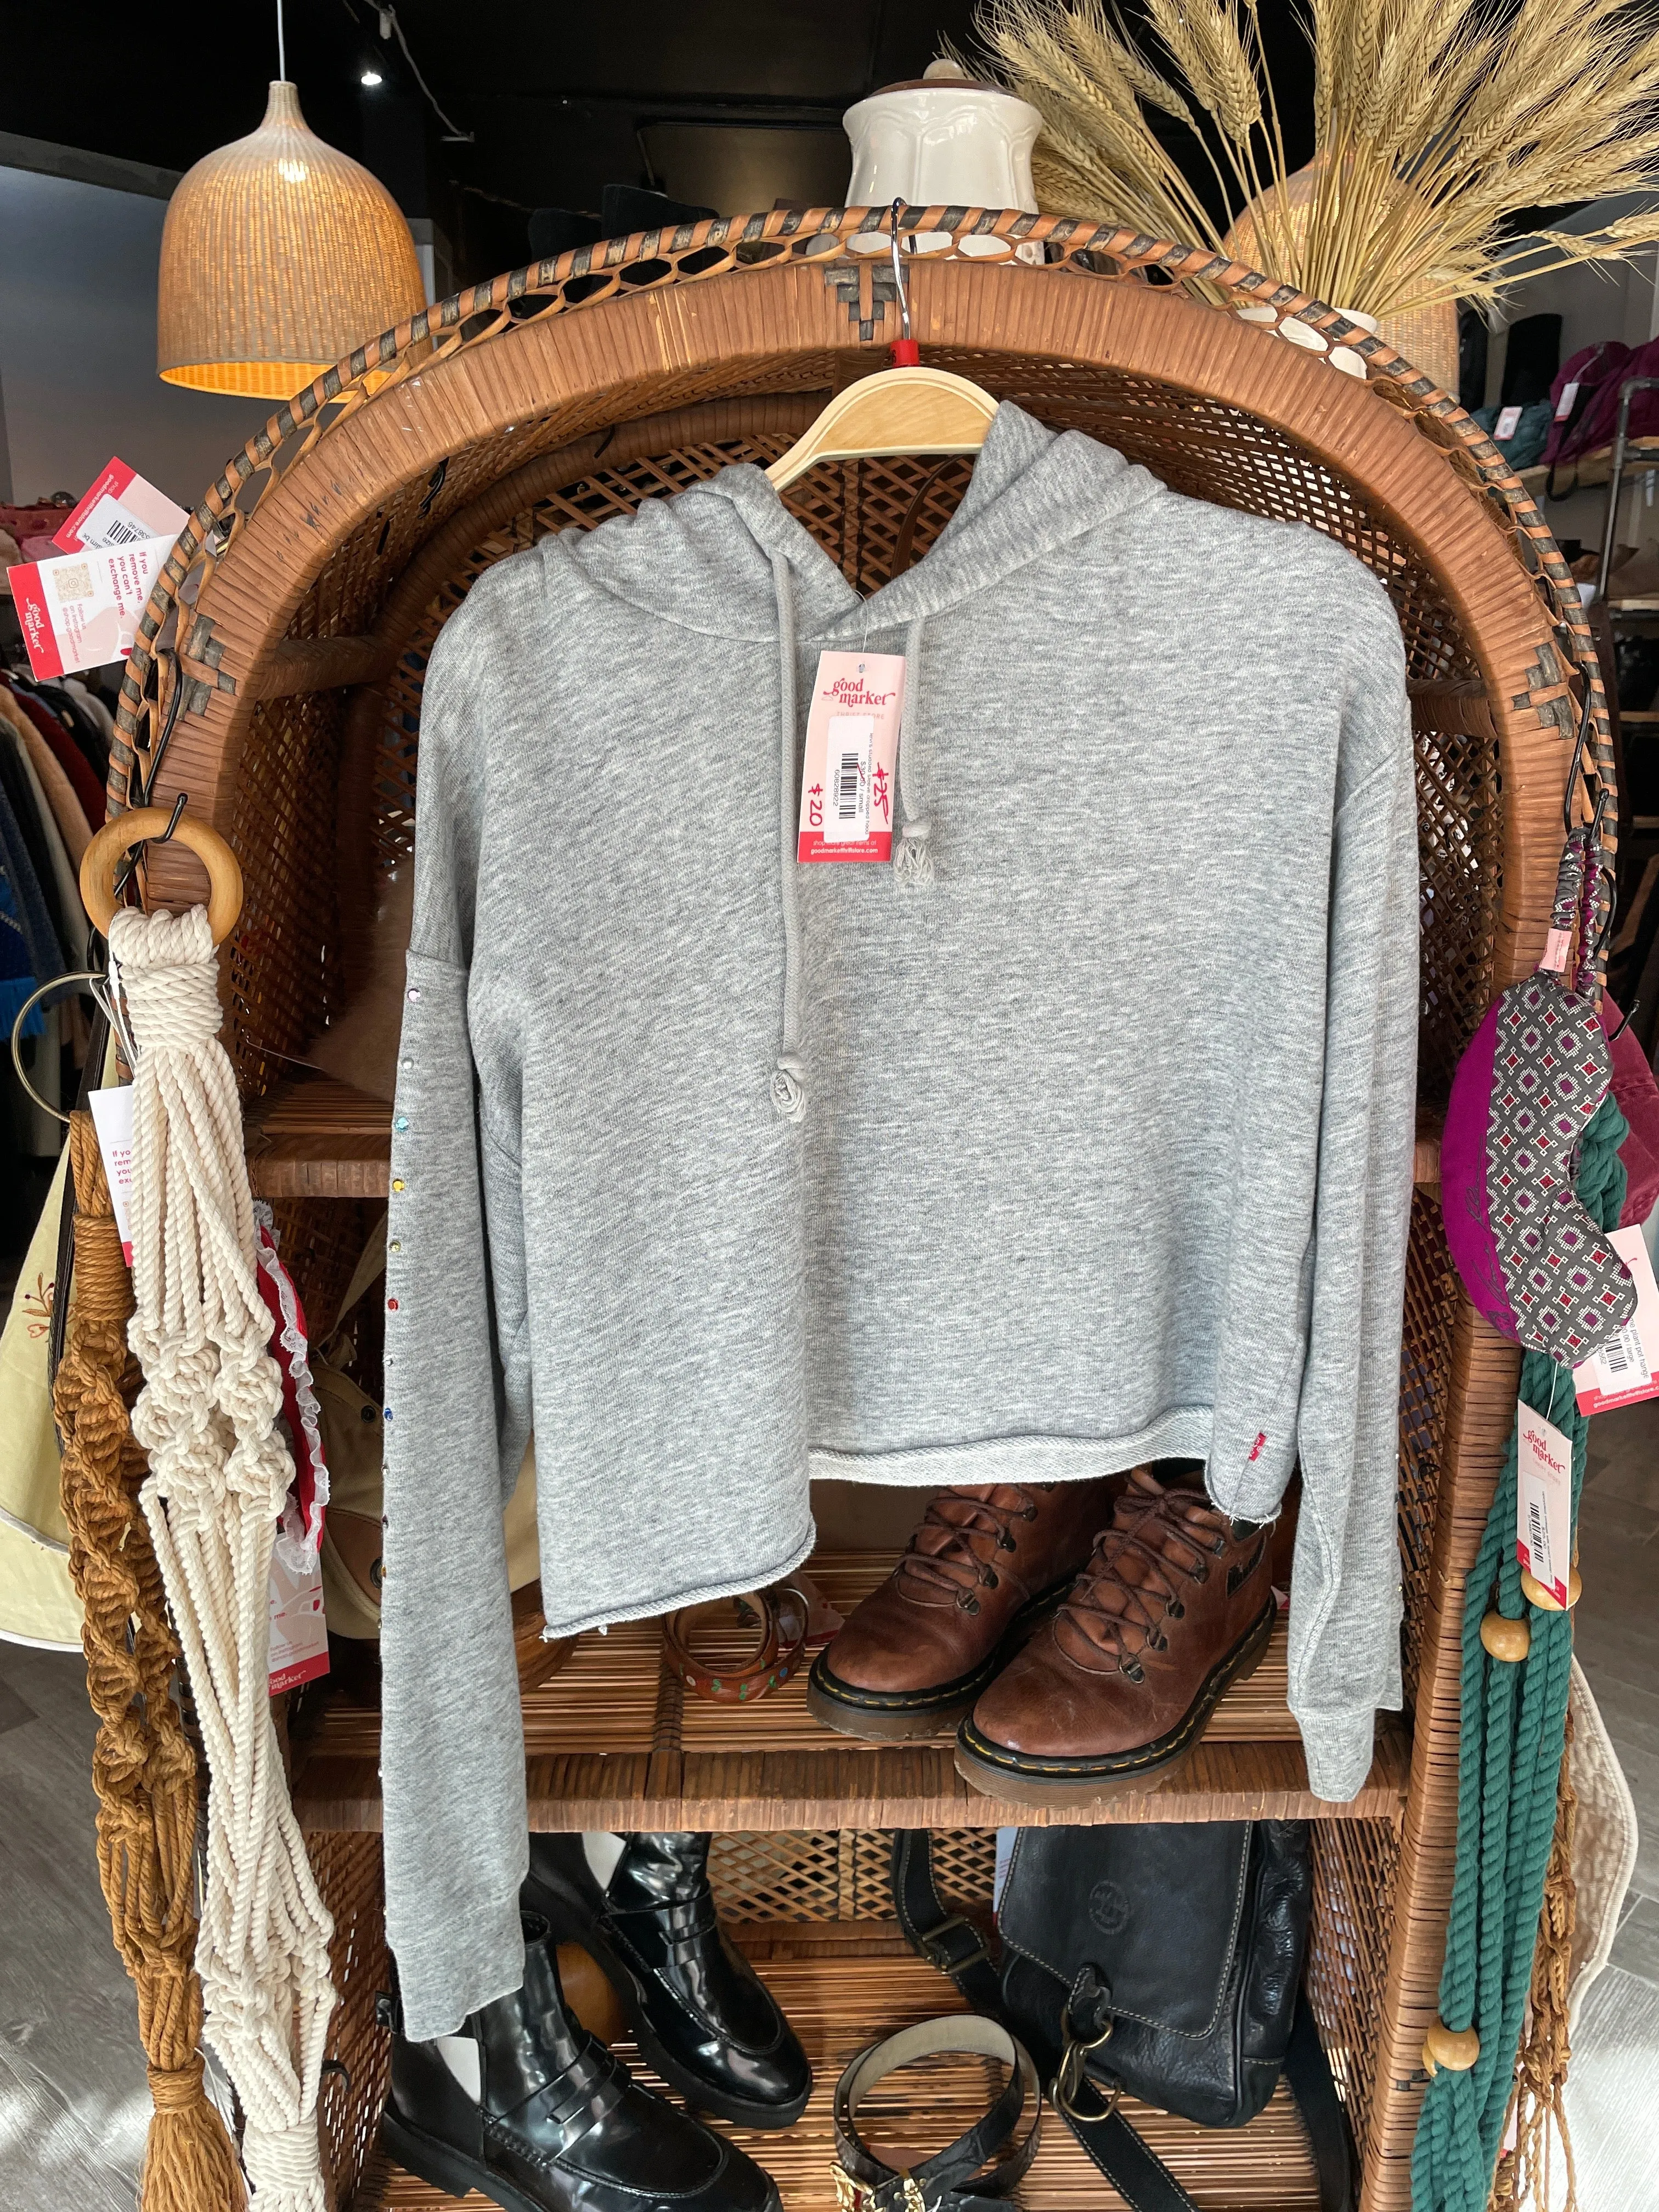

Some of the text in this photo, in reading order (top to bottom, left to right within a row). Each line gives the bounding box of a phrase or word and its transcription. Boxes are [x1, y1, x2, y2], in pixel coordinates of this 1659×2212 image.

[117, 556, 133, 595] you can't
[129, 554, 140, 585] remove
[139, 559, 149, 574] you
[108, 558, 122, 601] exchange
[26, 597, 45, 629] good
[25, 612, 44, 653] market
[823, 678, 864, 696] good
[838, 691, 896, 708] market
[808, 783, 823, 826] $20
[810, 847, 878, 855] goodmarketthriftstore.com
[1629, 1329, 1641, 1346] plant
[1598, 1348, 1607, 1364] 5562
[1626, 1347, 1634, 1363] large
[1634, 1346, 1644, 1357] pot
[1593, 1386, 1659, 1409] goodmarketthriftstore.c
[1522, 1430, 1547, 1451] good
[1532, 1443, 1566, 1474] market
[269, 1673, 286, 1684] ood
[271, 1670, 307, 1690] market
